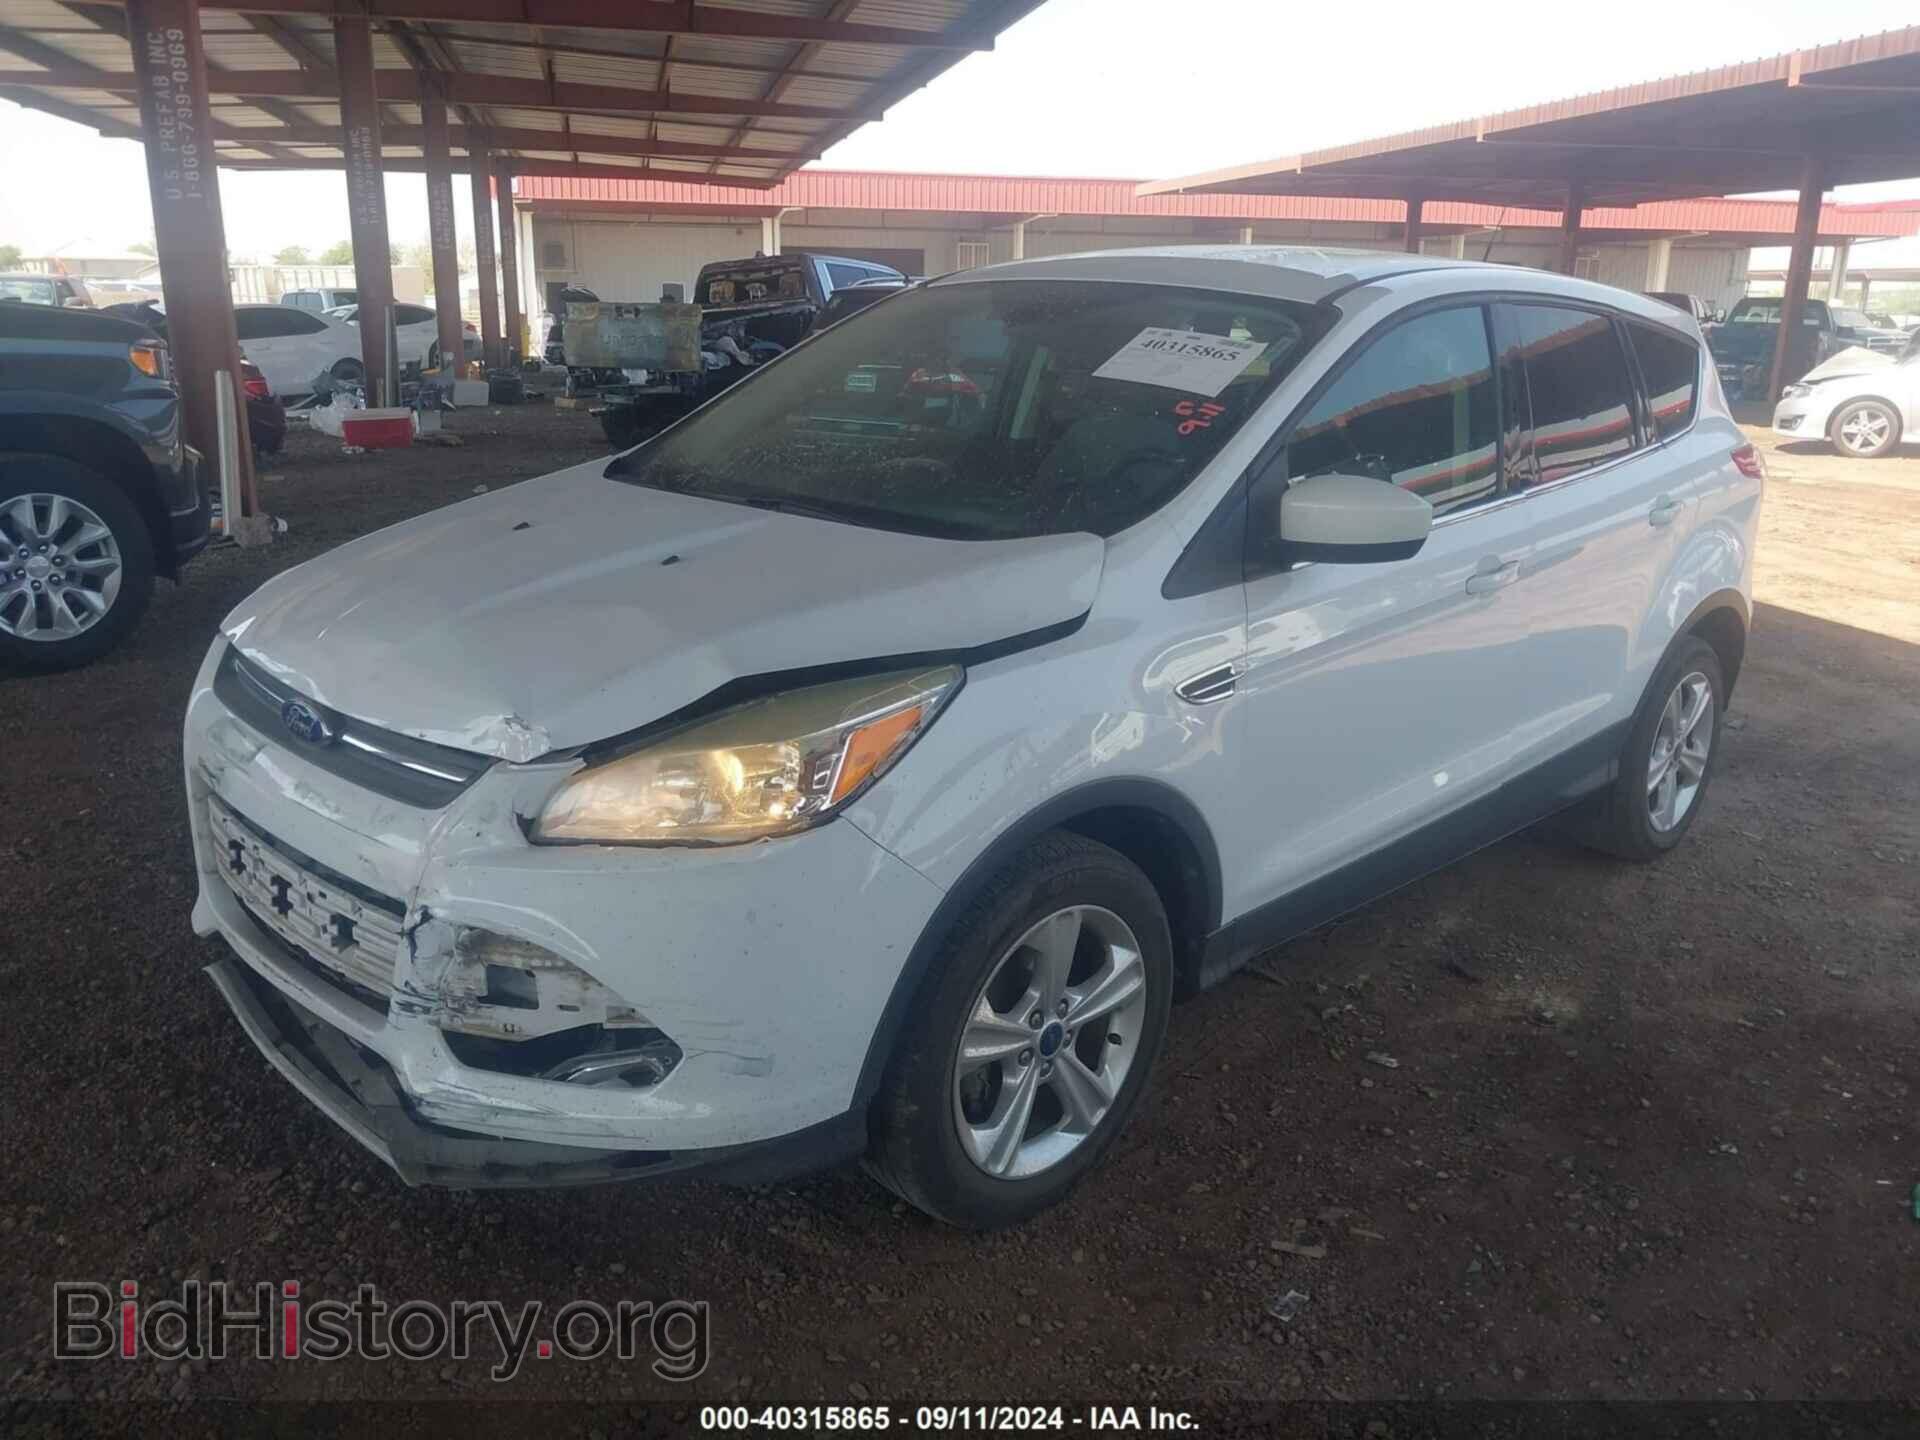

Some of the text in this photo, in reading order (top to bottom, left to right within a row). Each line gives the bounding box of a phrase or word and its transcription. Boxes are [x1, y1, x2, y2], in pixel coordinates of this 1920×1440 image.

[153, 75, 177, 152] PREFAB
[167, 28, 202, 199] 1-866-799-0969
[1141, 338, 1241, 361] 40315865
